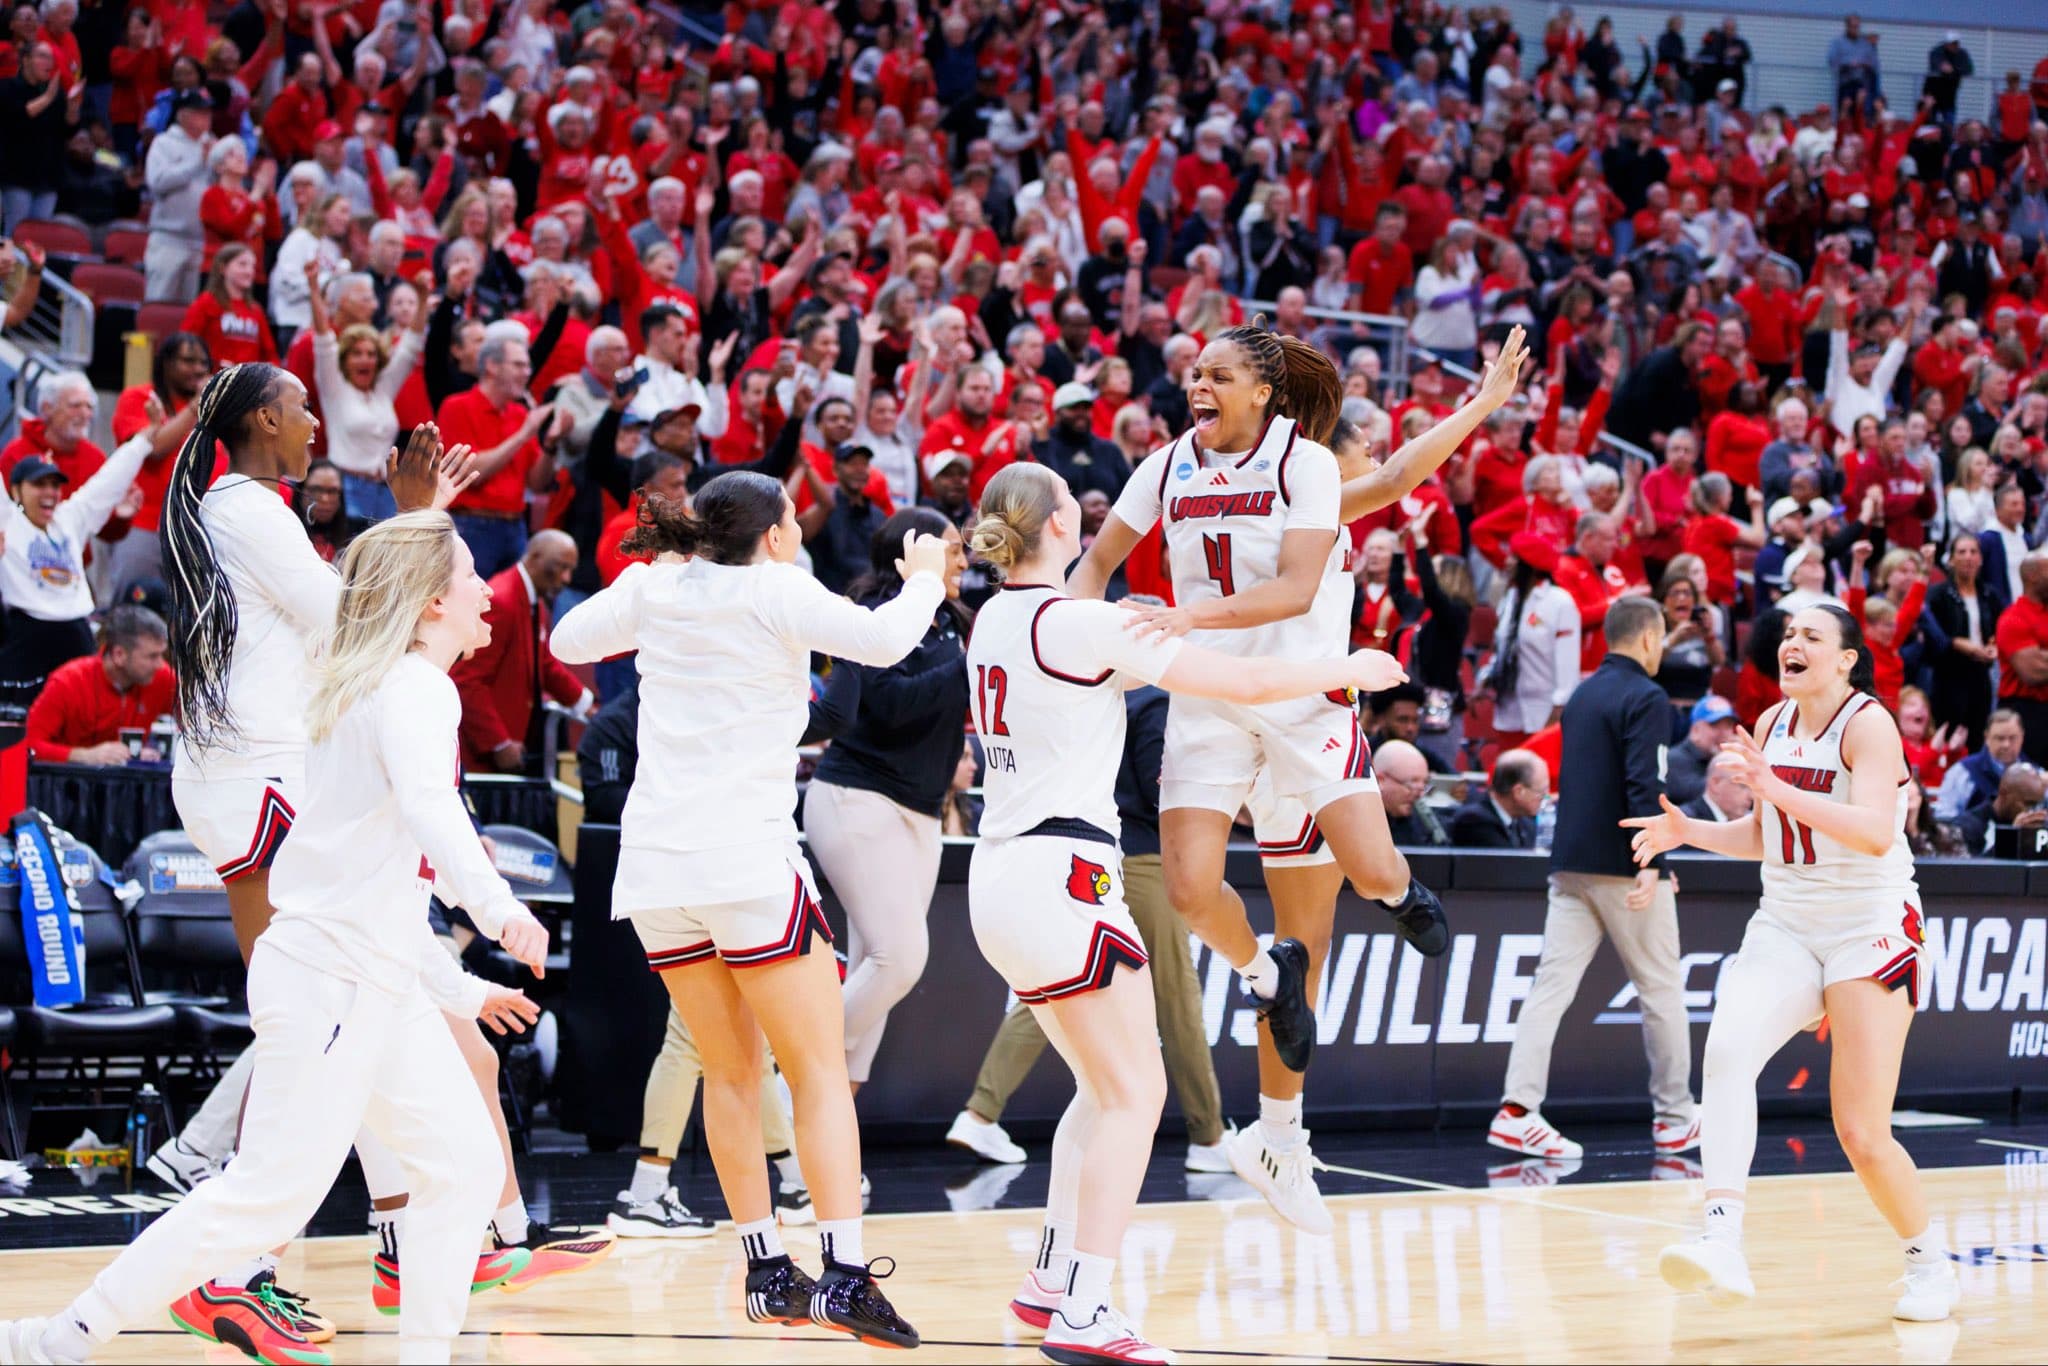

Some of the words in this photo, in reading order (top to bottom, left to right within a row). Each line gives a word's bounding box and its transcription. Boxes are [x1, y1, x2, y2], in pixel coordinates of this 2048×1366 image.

[1169, 490, 1276, 522] LOUISVILLE
[1202, 531, 1235, 597] 4
[977, 664, 1010, 737] 12
[1774, 804, 1816, 865] 11
[17, 832, 55, 911] SECOND
[36, 914, 71, 985] ROUND
[1187, 933, 1546, 1046] IVILLE
[1917, 917, 2048, 1012] NCA
[0, 1192, 187, 1217] REA
